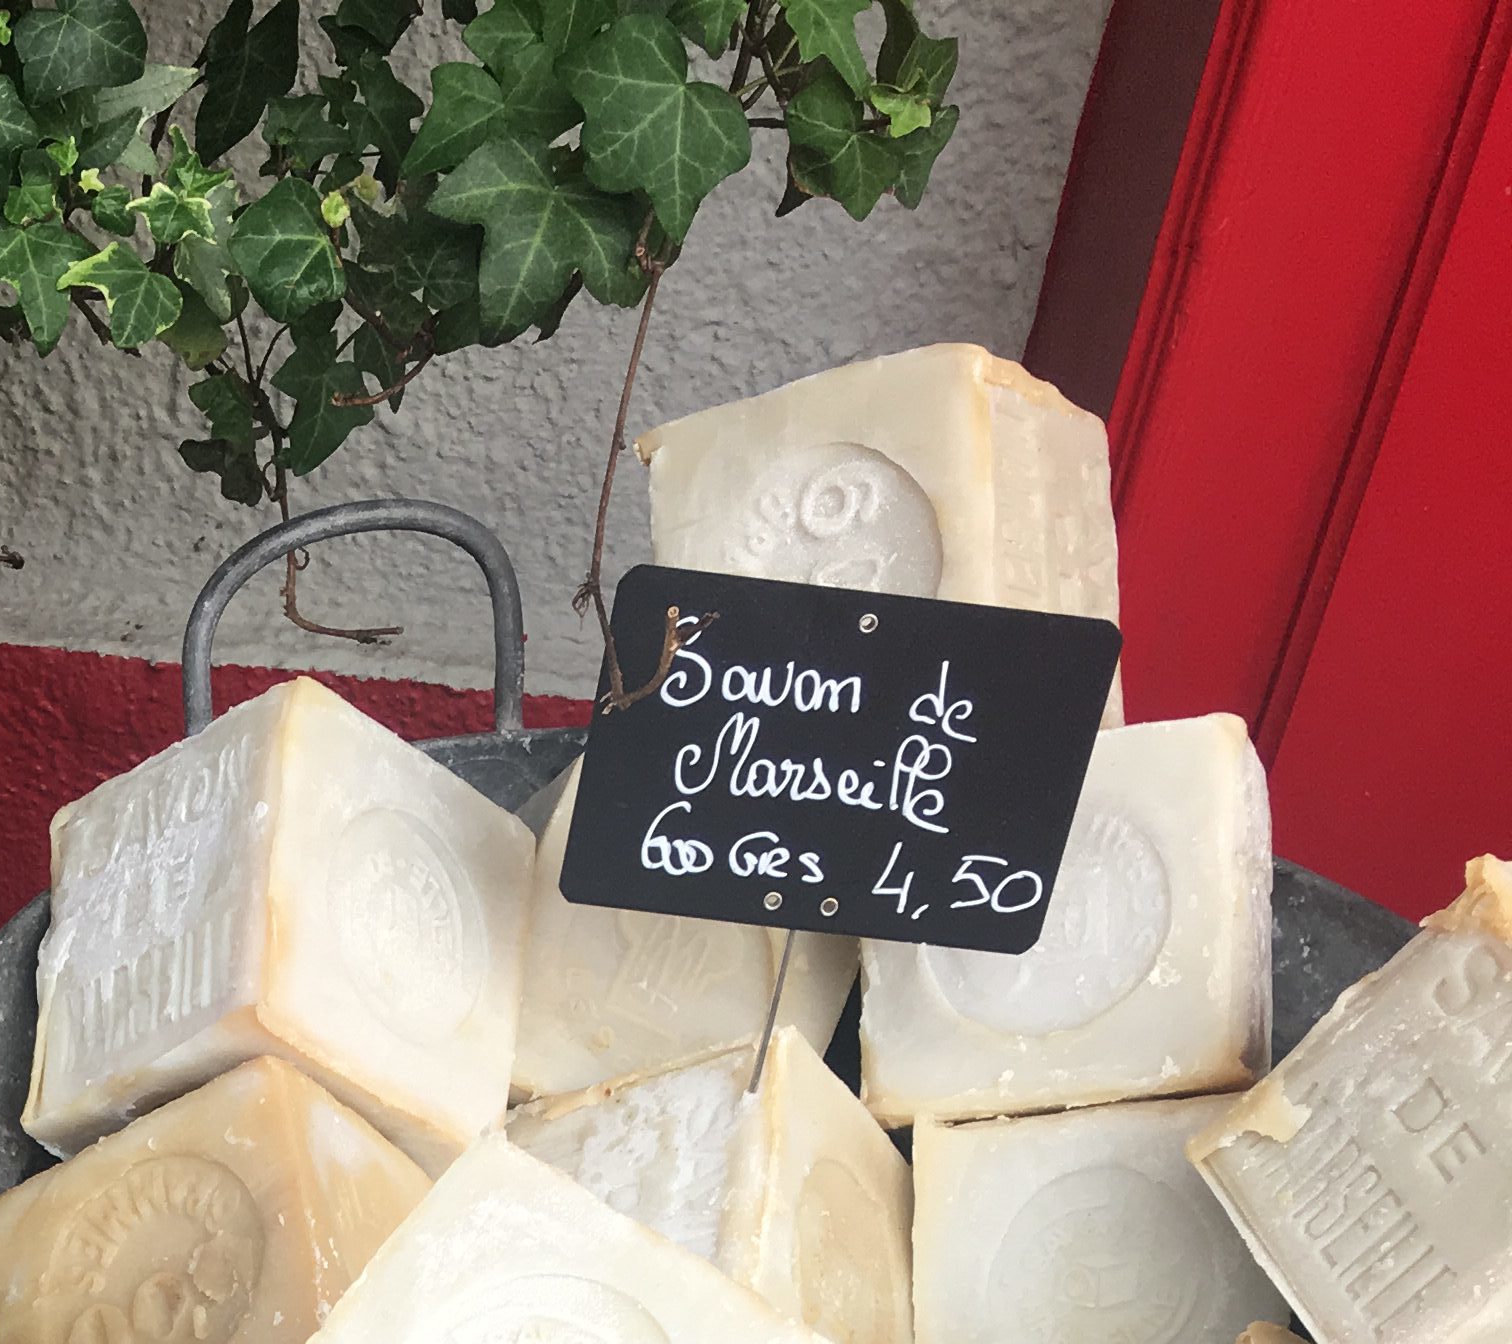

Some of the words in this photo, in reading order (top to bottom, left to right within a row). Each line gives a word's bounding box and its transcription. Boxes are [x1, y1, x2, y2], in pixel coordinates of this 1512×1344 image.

[660, 616, 860, 713] Savon
[909, 660, 976, 742] de
[675, 712, 952, 833] Marseille
[872, 841, 1042, 919] 4,50
[1391, 1077, 1487, 1185] DE
